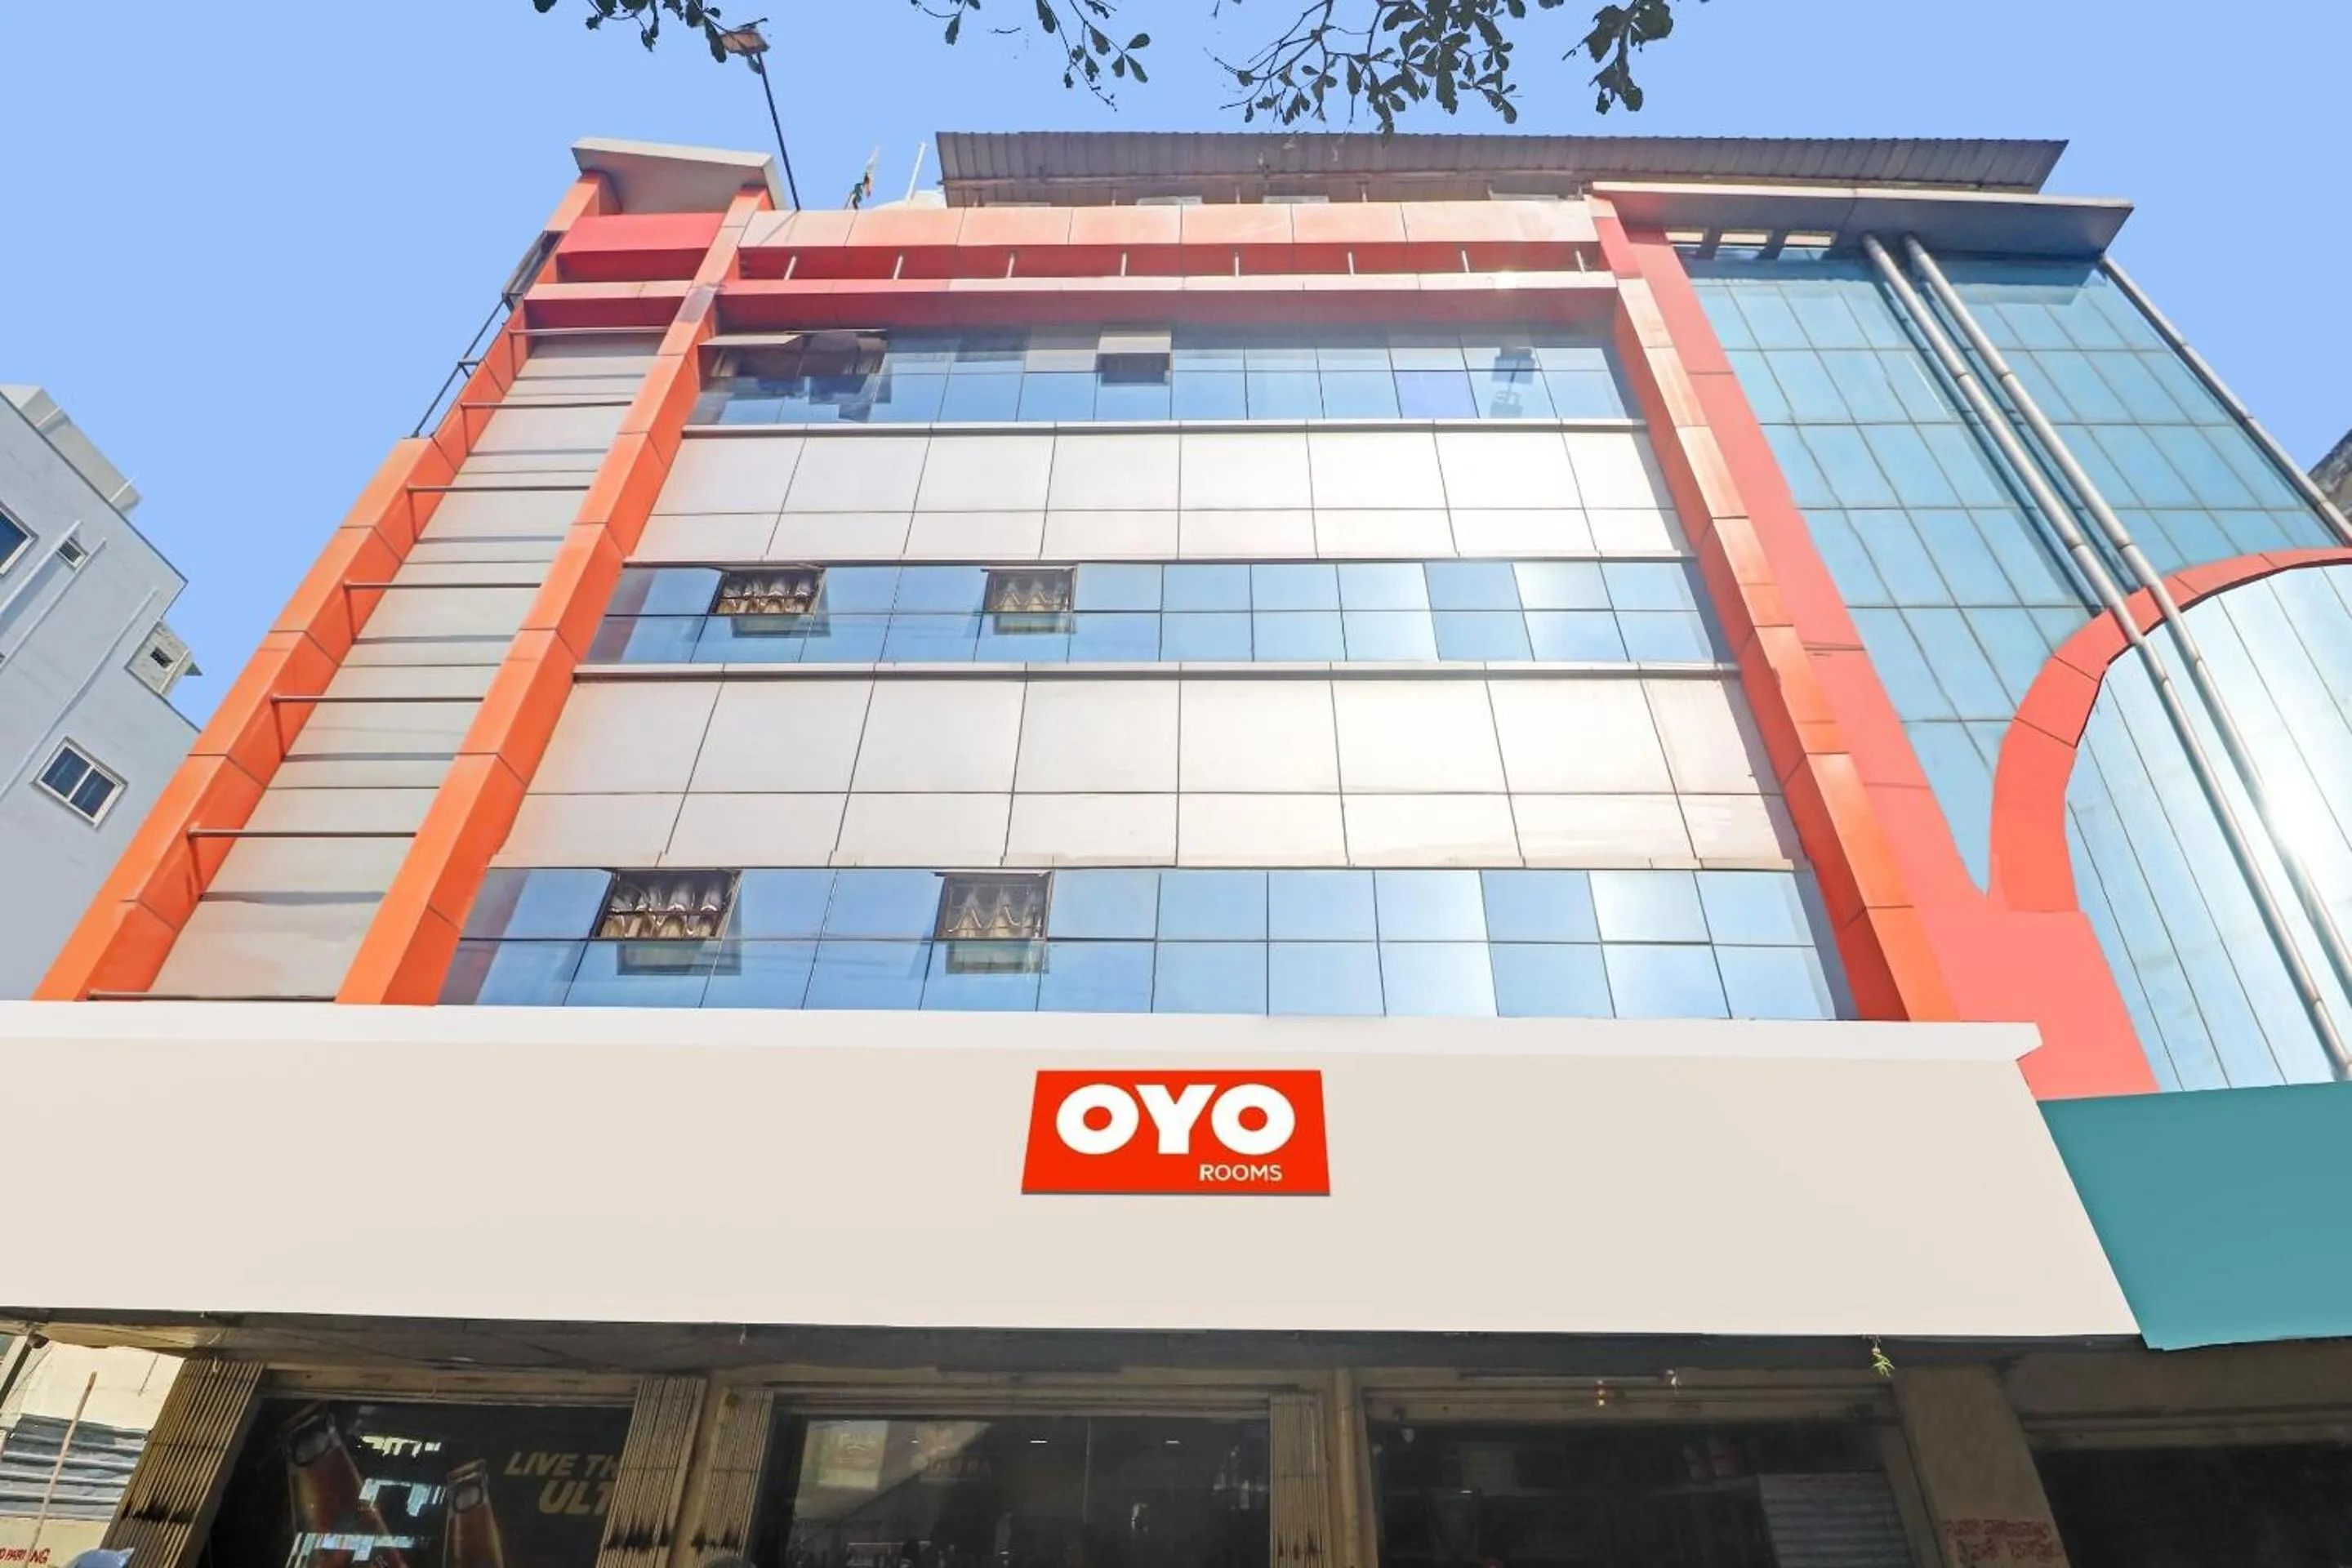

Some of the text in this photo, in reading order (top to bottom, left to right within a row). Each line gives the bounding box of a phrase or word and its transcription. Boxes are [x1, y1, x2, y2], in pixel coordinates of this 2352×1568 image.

[1056, 1082, 1296, 1156] OYO
[1199, 1164, 1283, 1182] ROOMS
[503, 1451, 579, 1476] LIVE
